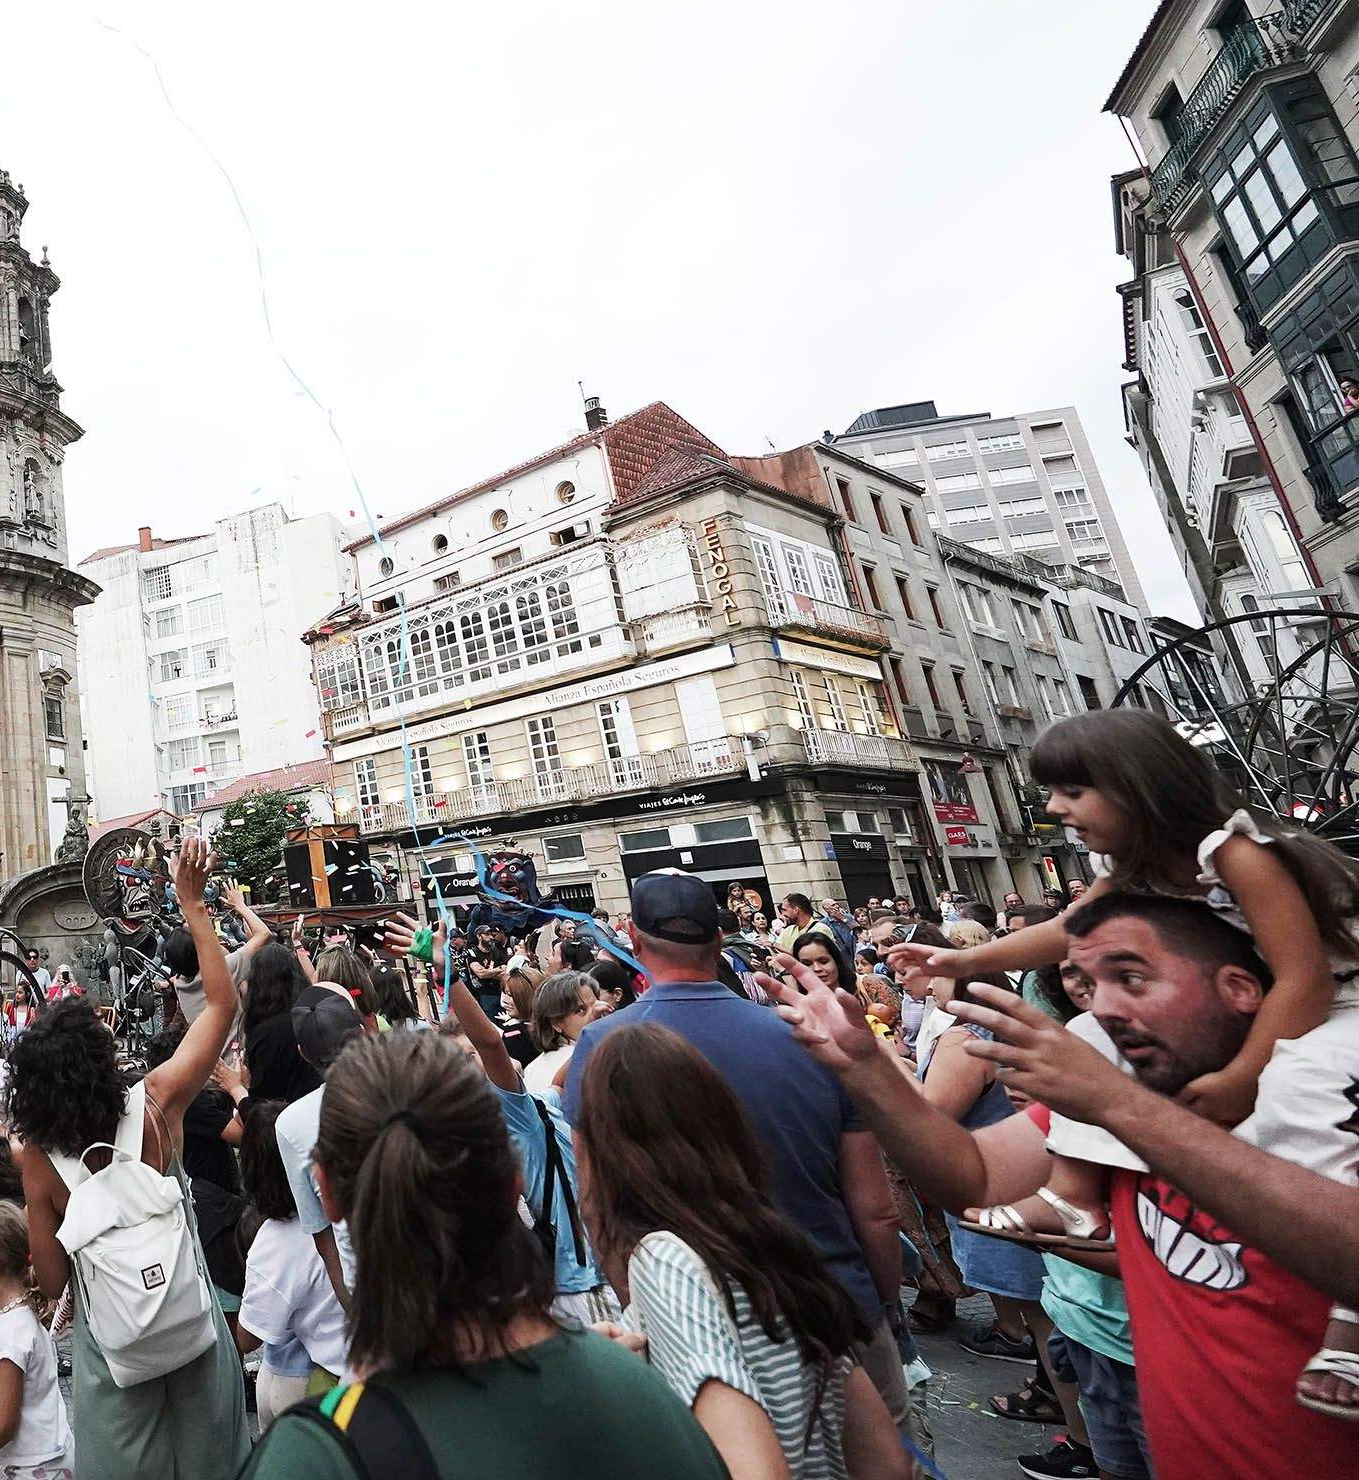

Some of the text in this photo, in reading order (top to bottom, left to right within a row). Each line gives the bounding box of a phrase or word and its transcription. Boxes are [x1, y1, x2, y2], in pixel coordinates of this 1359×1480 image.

[701, 519, 741, 626] FENOGAL
[545, 666, 680, 705] Alianza Española Seguros
[639, 801, 662, 809] VIAJES
[853, 839, 872, 851] Orange
